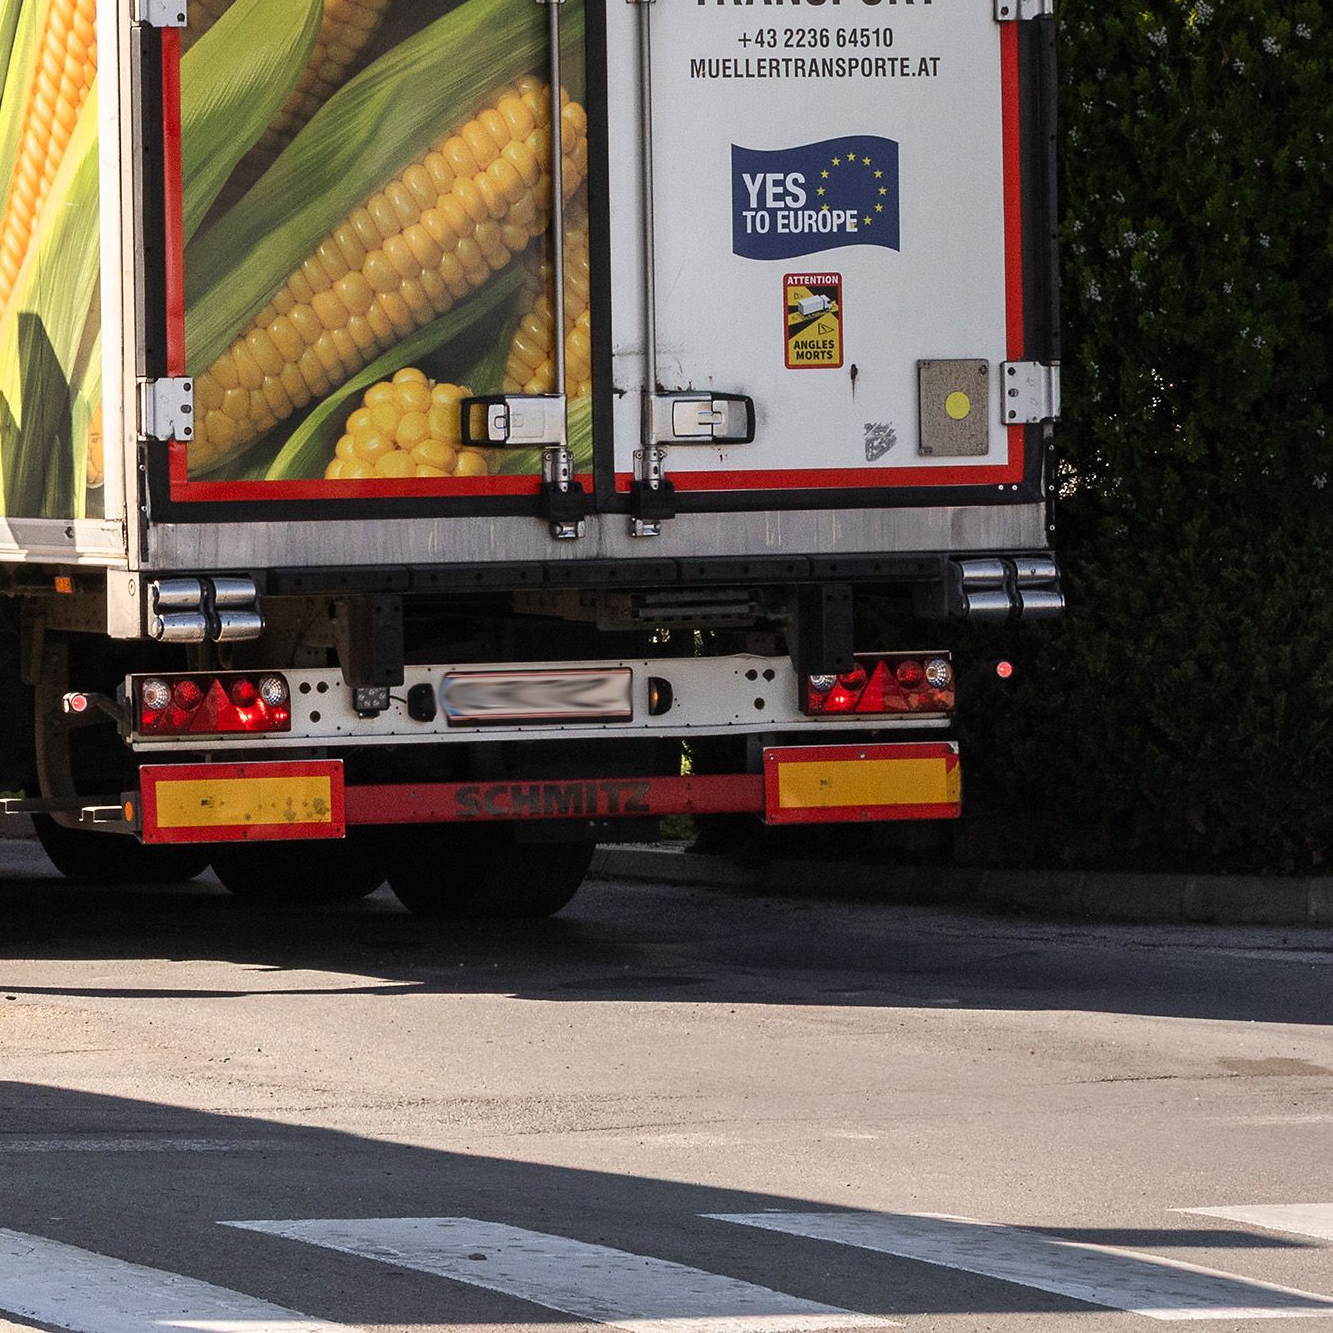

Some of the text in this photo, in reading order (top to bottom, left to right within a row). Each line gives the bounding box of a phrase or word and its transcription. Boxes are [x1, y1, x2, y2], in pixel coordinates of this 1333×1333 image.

[737, 27, 893, 49] +43 2236 64510
[690, 57, 941, 79] MUELLERTRANSPORTE.AT
[741, 172, 807, 209] YES
[742, 209, 858, 234] TO EUROPE
[787, 275, 839, 285] ATTENTION
[793, 340, 835, 350] ANGLES
[796, 350, 833, 361] MORTS
[454, 781, 651, 818] SCHMITZ
